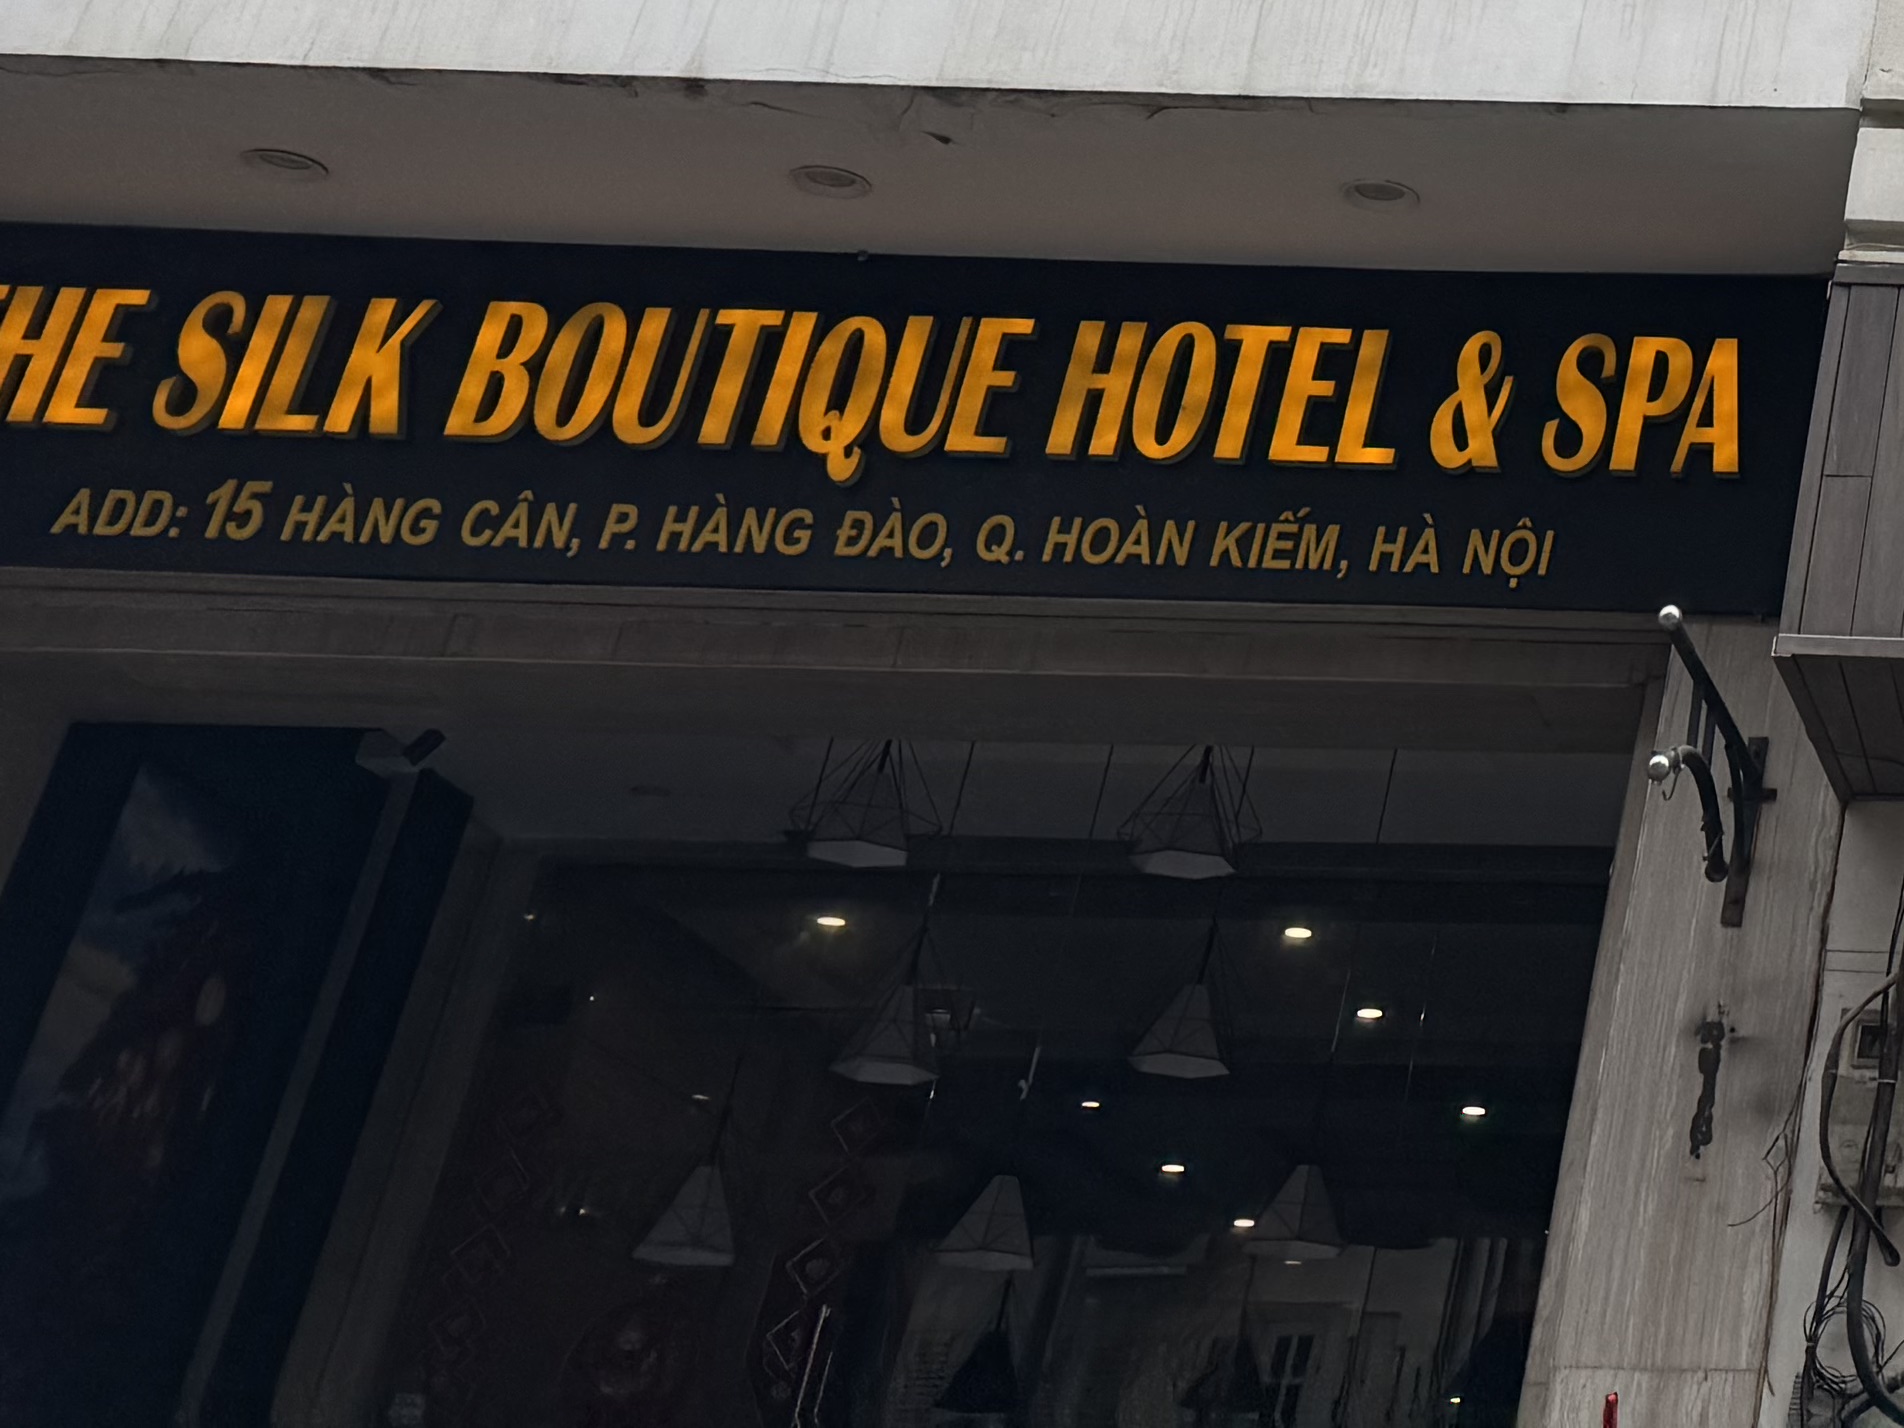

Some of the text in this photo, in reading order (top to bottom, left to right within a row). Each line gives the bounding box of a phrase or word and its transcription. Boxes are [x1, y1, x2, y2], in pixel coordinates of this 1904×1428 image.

[0, 284, 1741, 484] HE SILK BOUTIQUE HOTEL & SPA
[50, 480, 1556, 589] ADD: 15 HÀNG CÂN, P. HÀNG ĐÀO, Q. HOÀN KIẾM, HÀ NỘI
